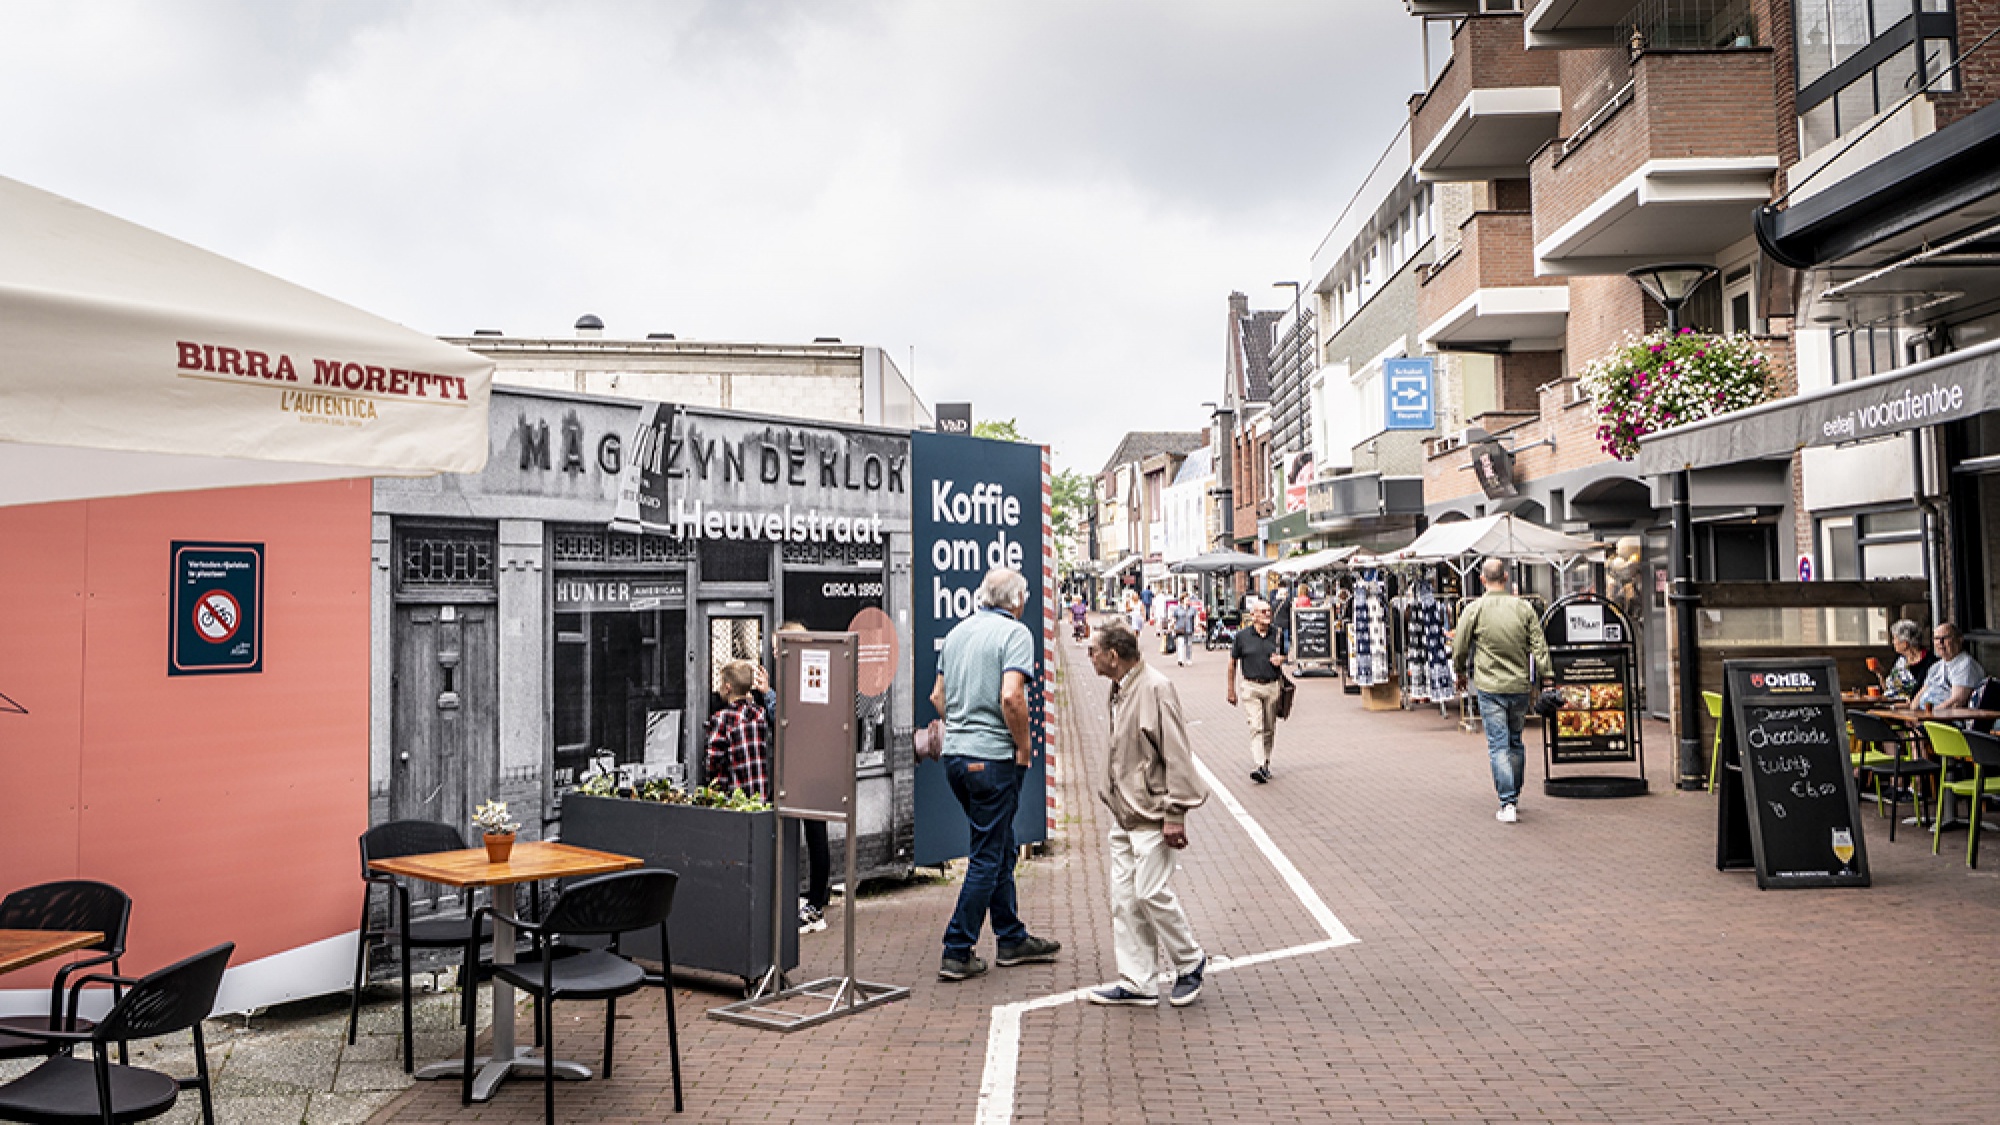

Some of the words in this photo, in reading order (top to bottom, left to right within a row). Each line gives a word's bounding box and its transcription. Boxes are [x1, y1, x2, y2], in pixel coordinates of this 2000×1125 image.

[176, 340, 298, 382] BIRRA
[312, 358, 469, 401] MORETTI
[280, 390, 379, 420] L'AUTENTICA
[518, 418, 745, 482] MAGZYN
[760, 440, 807, 487] DE
[819, 445, 905, 494] KLOK
[676, 499, 883, 544] Heuvelstraat
[931, 478, 1021, 527] Koffie
[931, 538, 981, 572] om
[986, 529, 1024, 570] de
[557, 582, 630, 602] HUNTER
[822, 582, 857, 598] CIRCA
[858, 582, 883, 598] 1950
